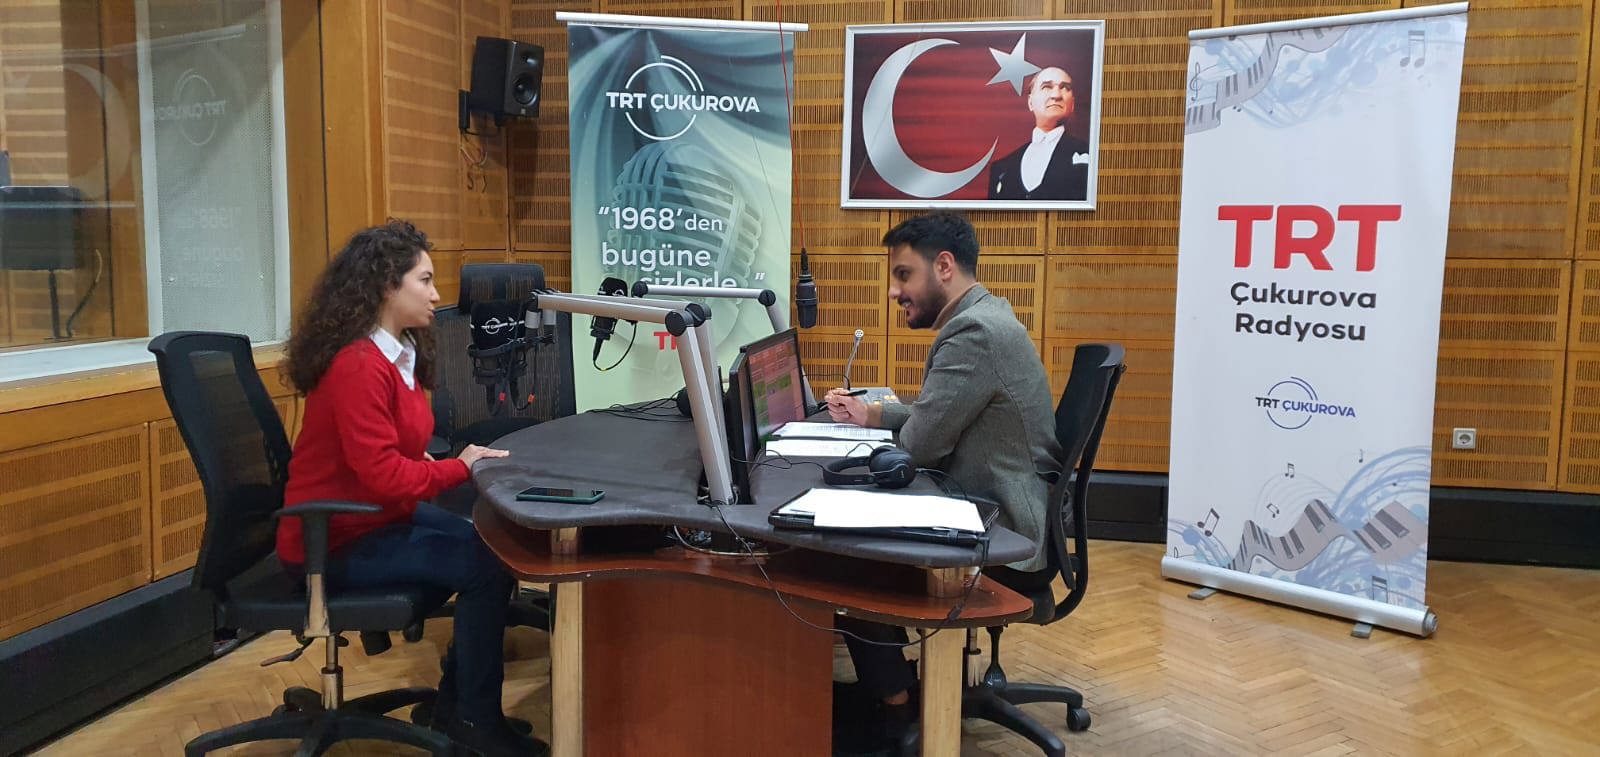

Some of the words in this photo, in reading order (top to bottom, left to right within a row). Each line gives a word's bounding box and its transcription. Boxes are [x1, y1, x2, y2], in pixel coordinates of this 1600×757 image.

[606, 91, 647, 109] TRT
[650, 93, 760, 113] ÇUKUROVA
[1218, 204, 1402, 272] TRT
[602, 241, 711, 272] bugüne
[1230, 281, 1377, 308] Çukurova
[1235, 313, 1366, 342] Radyosu
[1255, 397, 1280, 409] TRT
[1282, 400, 1356, 418] ÇUKUROVA
